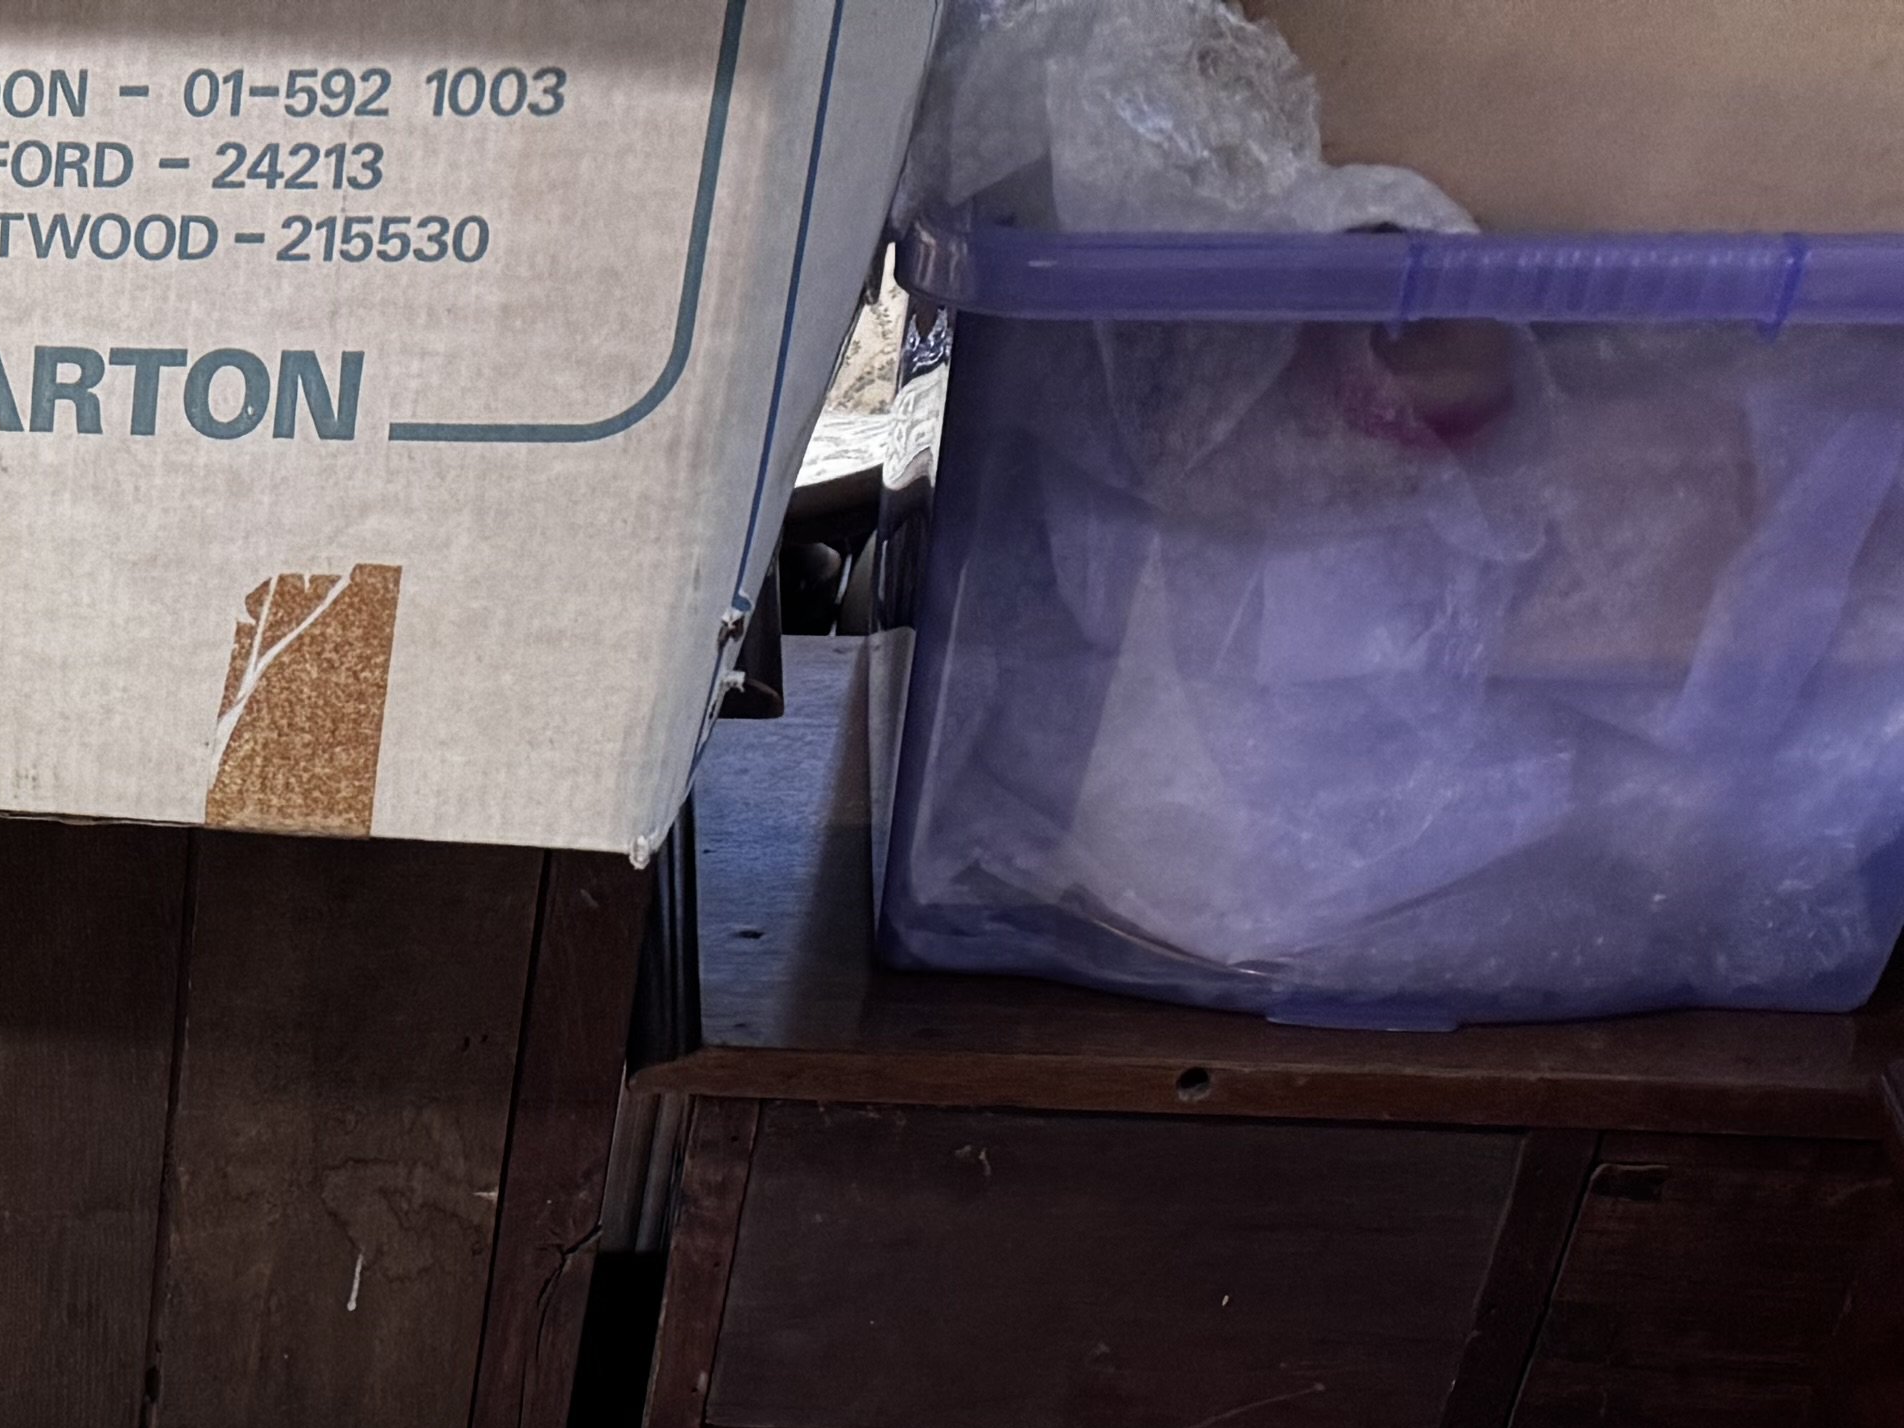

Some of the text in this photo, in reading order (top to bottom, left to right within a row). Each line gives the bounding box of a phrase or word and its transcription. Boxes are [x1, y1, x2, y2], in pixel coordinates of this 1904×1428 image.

[182, 66, 393, 118] 01-592
[424, 66, 568, 118] 1003
[211, 141, 385, 192] 24213
[276, 213, 491, 264] 215530
